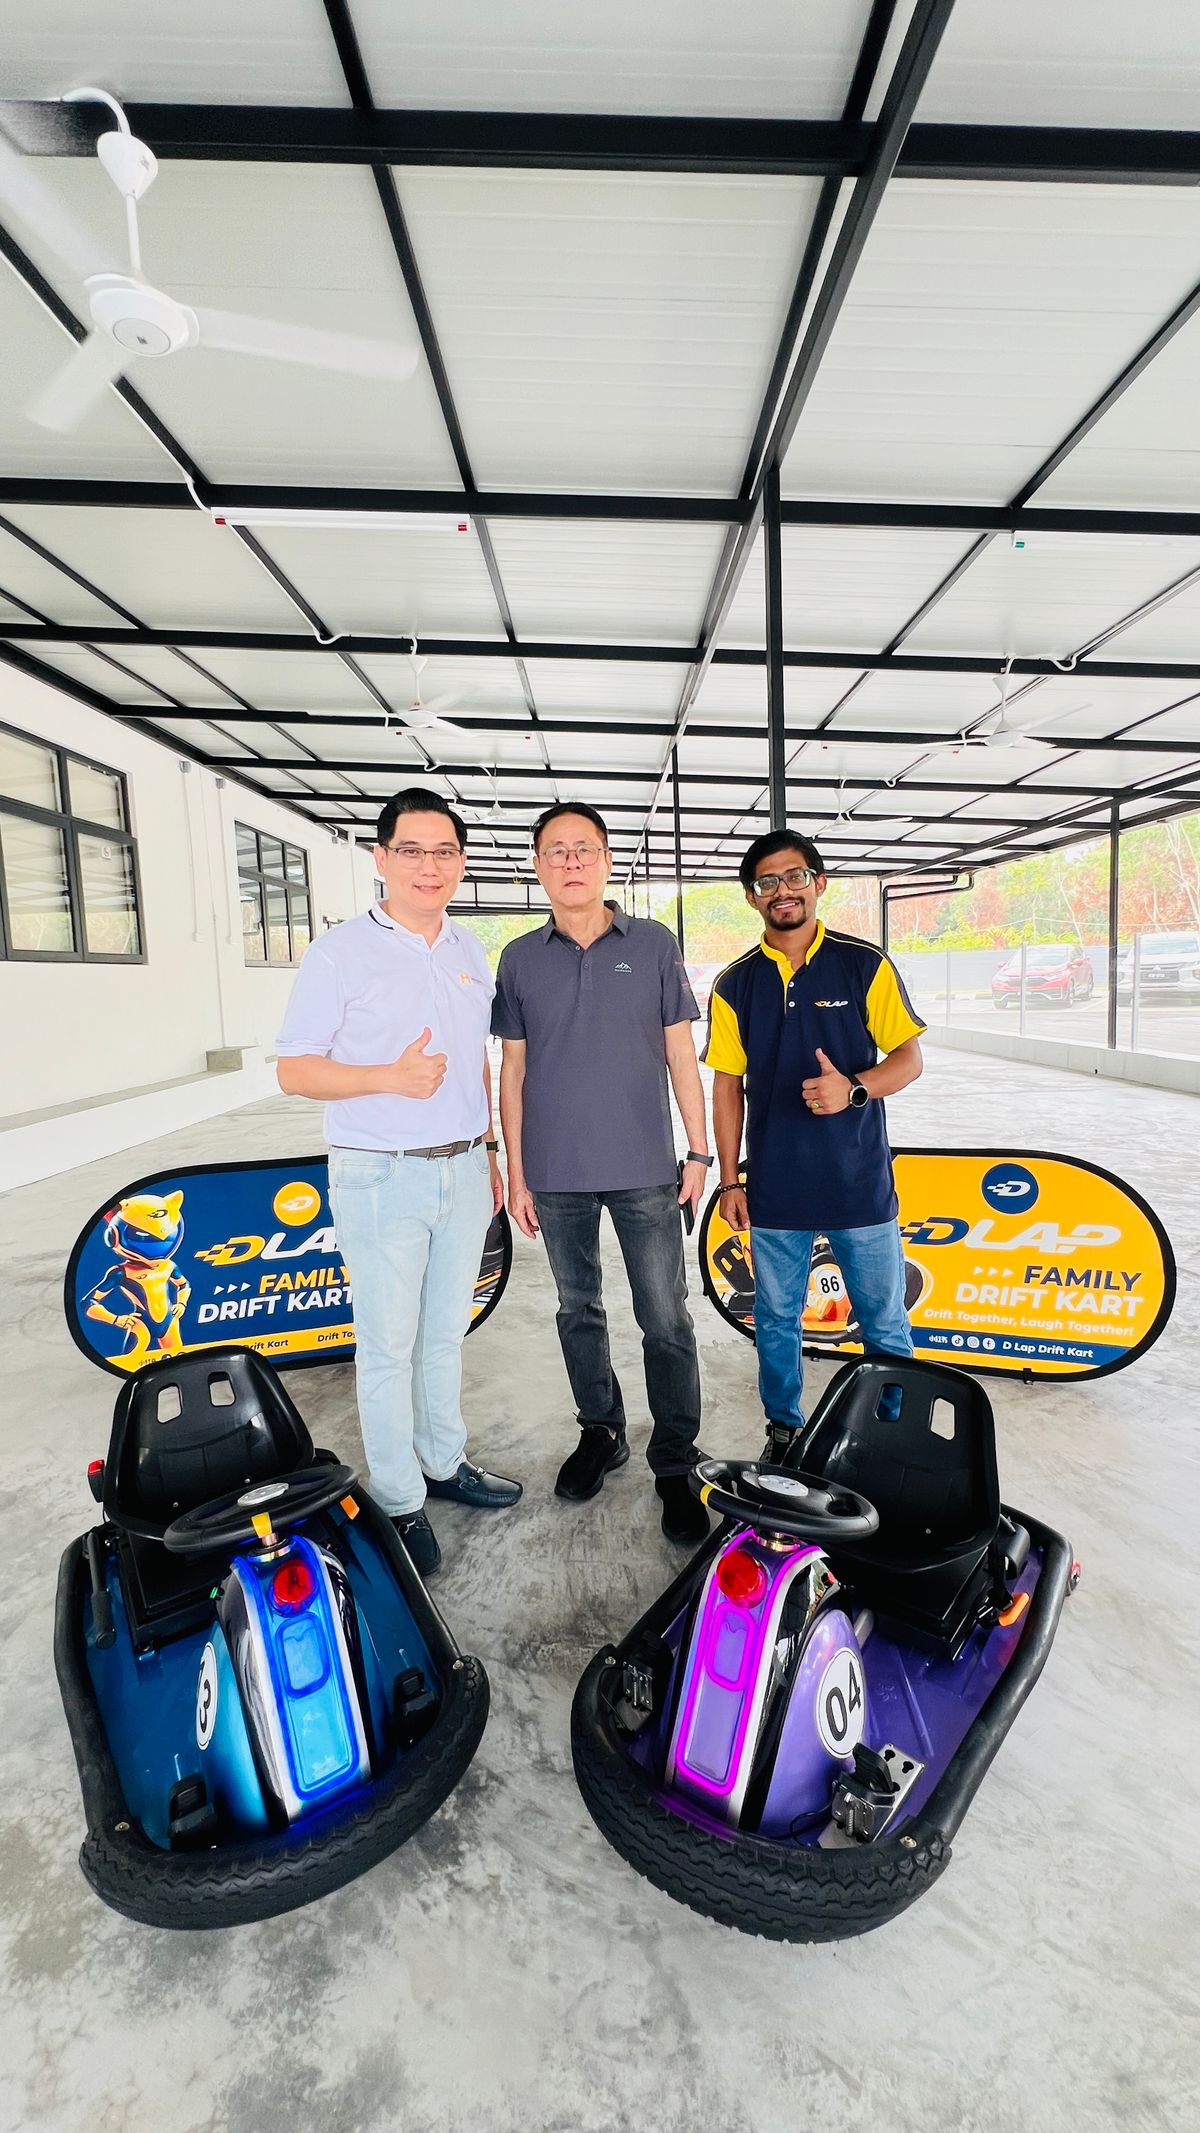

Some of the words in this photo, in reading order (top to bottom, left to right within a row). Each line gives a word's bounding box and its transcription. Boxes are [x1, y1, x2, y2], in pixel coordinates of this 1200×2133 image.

[814, 1000, 849, 1008] DLAP
[194, 1226, 341, 1267] DLA
[900, 1216, 1122, 1254] DLAP
[259, 1265, 351, 1294] FAMILY
[820, 1275, 840, 1294] 86
[1024, 1265, 1142, 1291] FAMILY
[197, 1295, 282, 1324] DRIFT
[955, 1283, 1049, 1310] DRIFT
[1054, 1290, 1144, 1318] KART
[318, 1332, 339, 1342] Drift
[924, 1308, 953, 1320] Drift
[957, 1311, 1017, 1327] Together,
[1020, 1318, 1063, 1331] Laugh
[1068, 1320, 1134, 1337] Together!
[267, 1340, 288, 1348] Kart
[1002, 1341, 1012, 1350] D
[1014, 1342, 1036, 1354] Lap
[1038, 1345, 1065, 1355] Drift
[1067, 1347, 1094, 1358] Kart
[826, 1660, 861, 1742] 04
